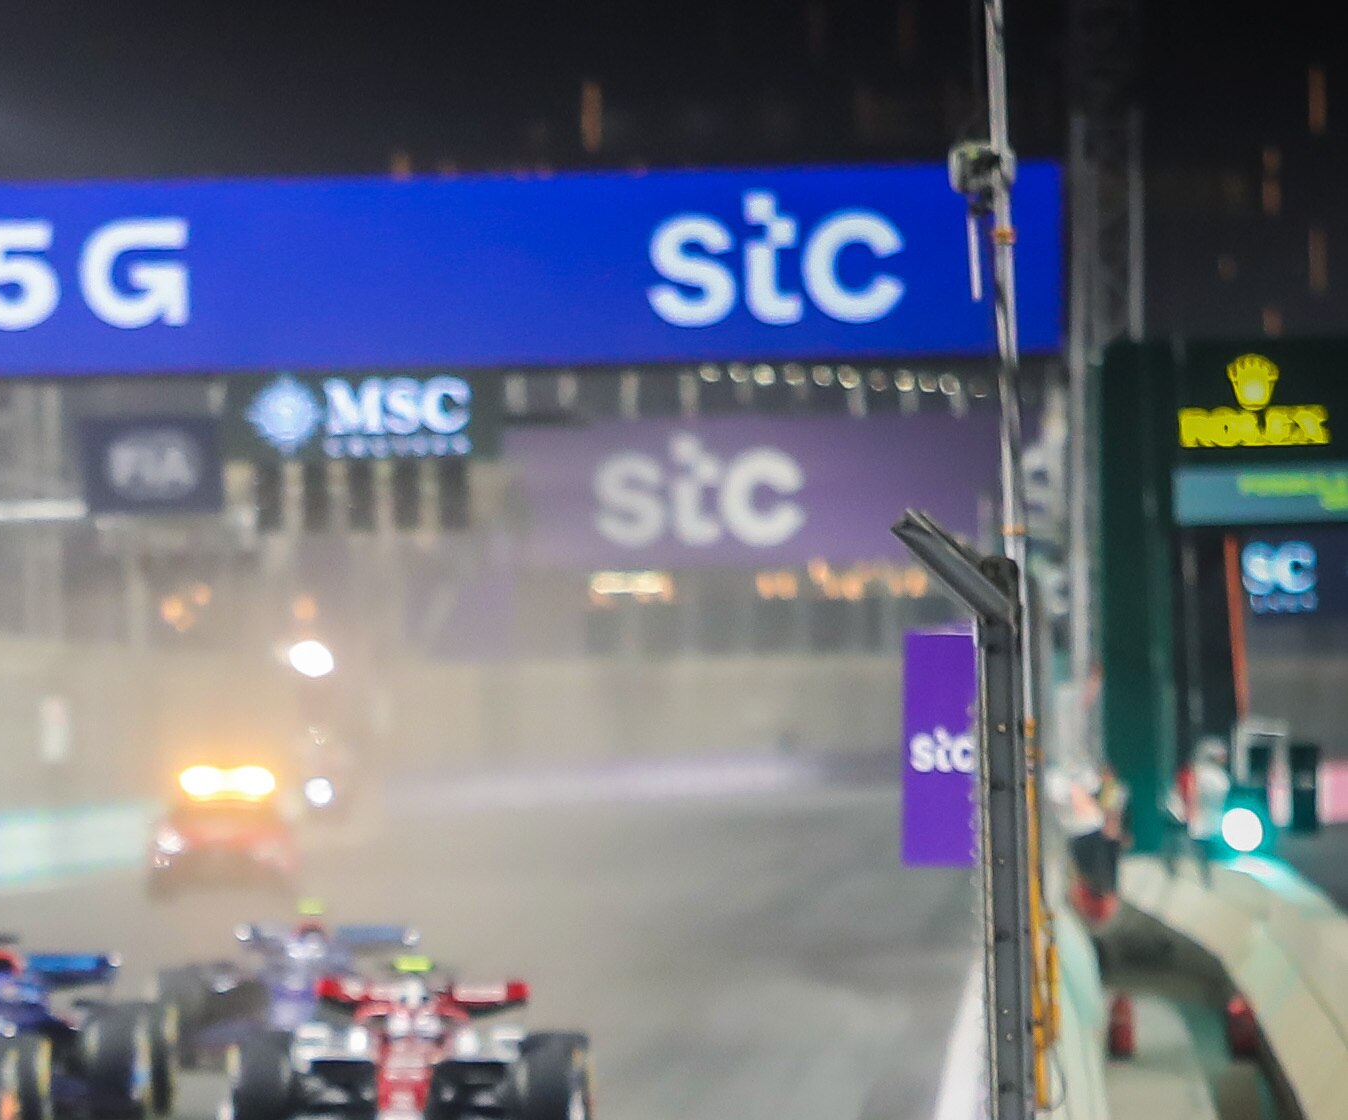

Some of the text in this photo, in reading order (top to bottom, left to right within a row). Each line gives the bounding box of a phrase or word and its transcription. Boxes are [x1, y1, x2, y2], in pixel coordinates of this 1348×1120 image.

[646, 188, 905, 328] stc
[322, 375, 472, 436] MSC
[1178, 404, 1331, 448] ROLEX
[594, 431, 807, 547] stc
[909, 726, 976, 773] stc
